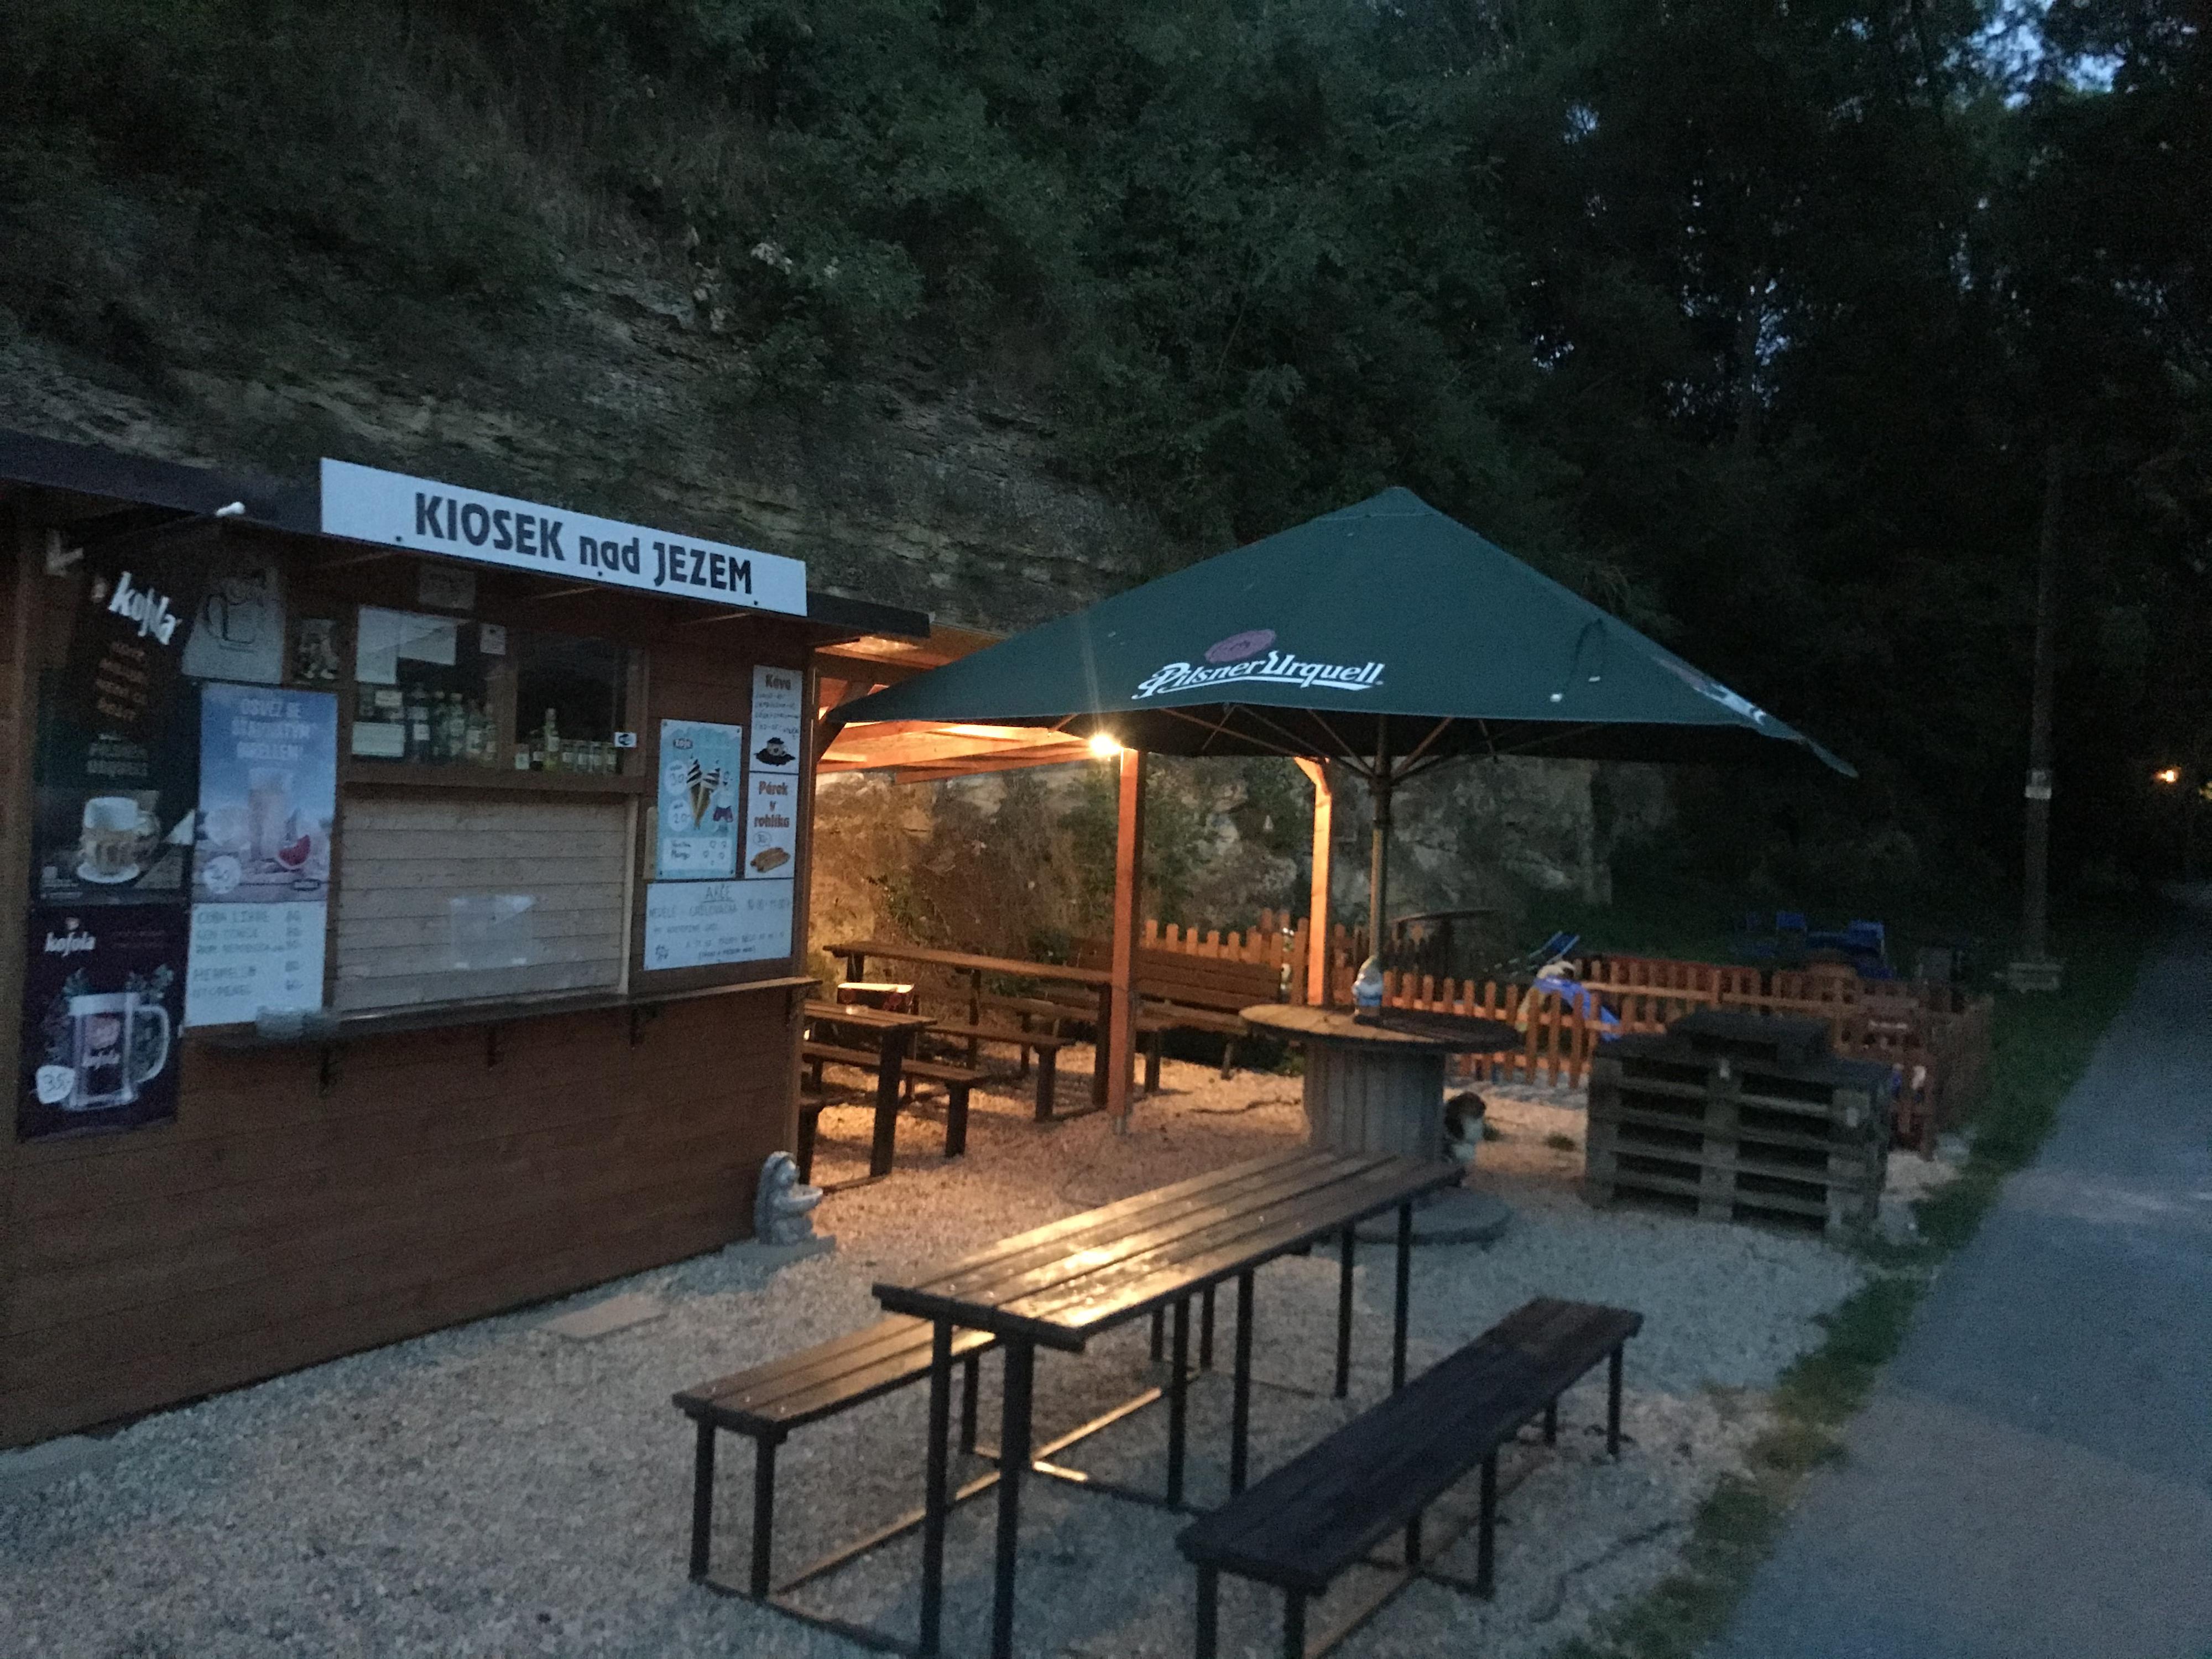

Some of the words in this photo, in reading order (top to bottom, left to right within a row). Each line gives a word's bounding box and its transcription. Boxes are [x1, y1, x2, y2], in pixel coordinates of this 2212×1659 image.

[416, 492, 565, 561] KIOSEK
[580, 536, 640, 573] nad
[653, 541, 753, 594] JEZEM
[1131, 660, 1265, 700] Pilsner
[1261, 650, 1385, 688] Urquell
[758, 780, 789, 795] Párek
